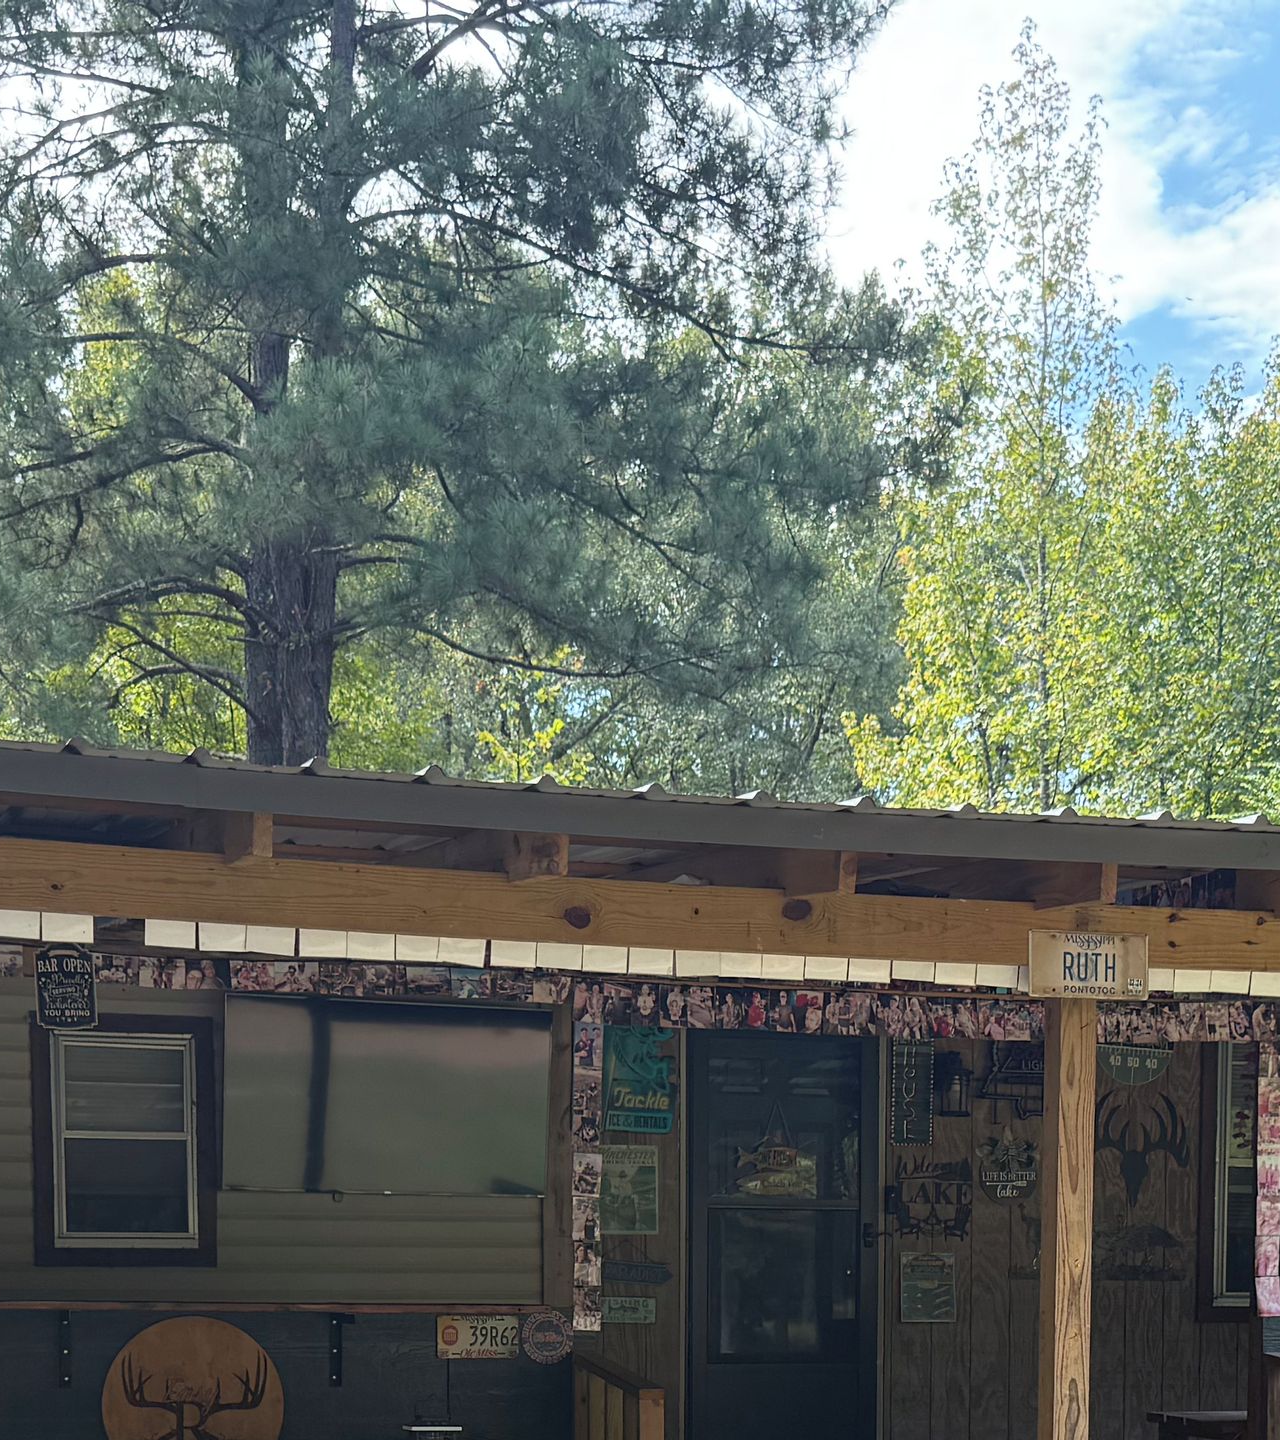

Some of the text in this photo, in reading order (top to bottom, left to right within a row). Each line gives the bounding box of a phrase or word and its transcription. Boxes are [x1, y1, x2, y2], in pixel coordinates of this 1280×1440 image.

[37, 958, 91, 973] BAR OPEN
[1063, 952, 1116, 982] RUTH
[1063, 985, 1116, 995] PONTOTOC
[44, 1009, 90, 1017] YOU BRING
[1109, 1055, 1157, 1069] 40 50 40
[614, 1087, 670, 1110] Tackle
[609, 1114, 621, 1127] ICE
[633, 1115, 668, 1129] RENTALS
[982, 1172, 998, 1181] LIFE
[1000, 1172, 1007, 1181] IS
[900, 1182, 972, 1205] LAKE
[997, 1184, 1019, 1198] lake
[469, 1326, 518, 1347] 39R62
